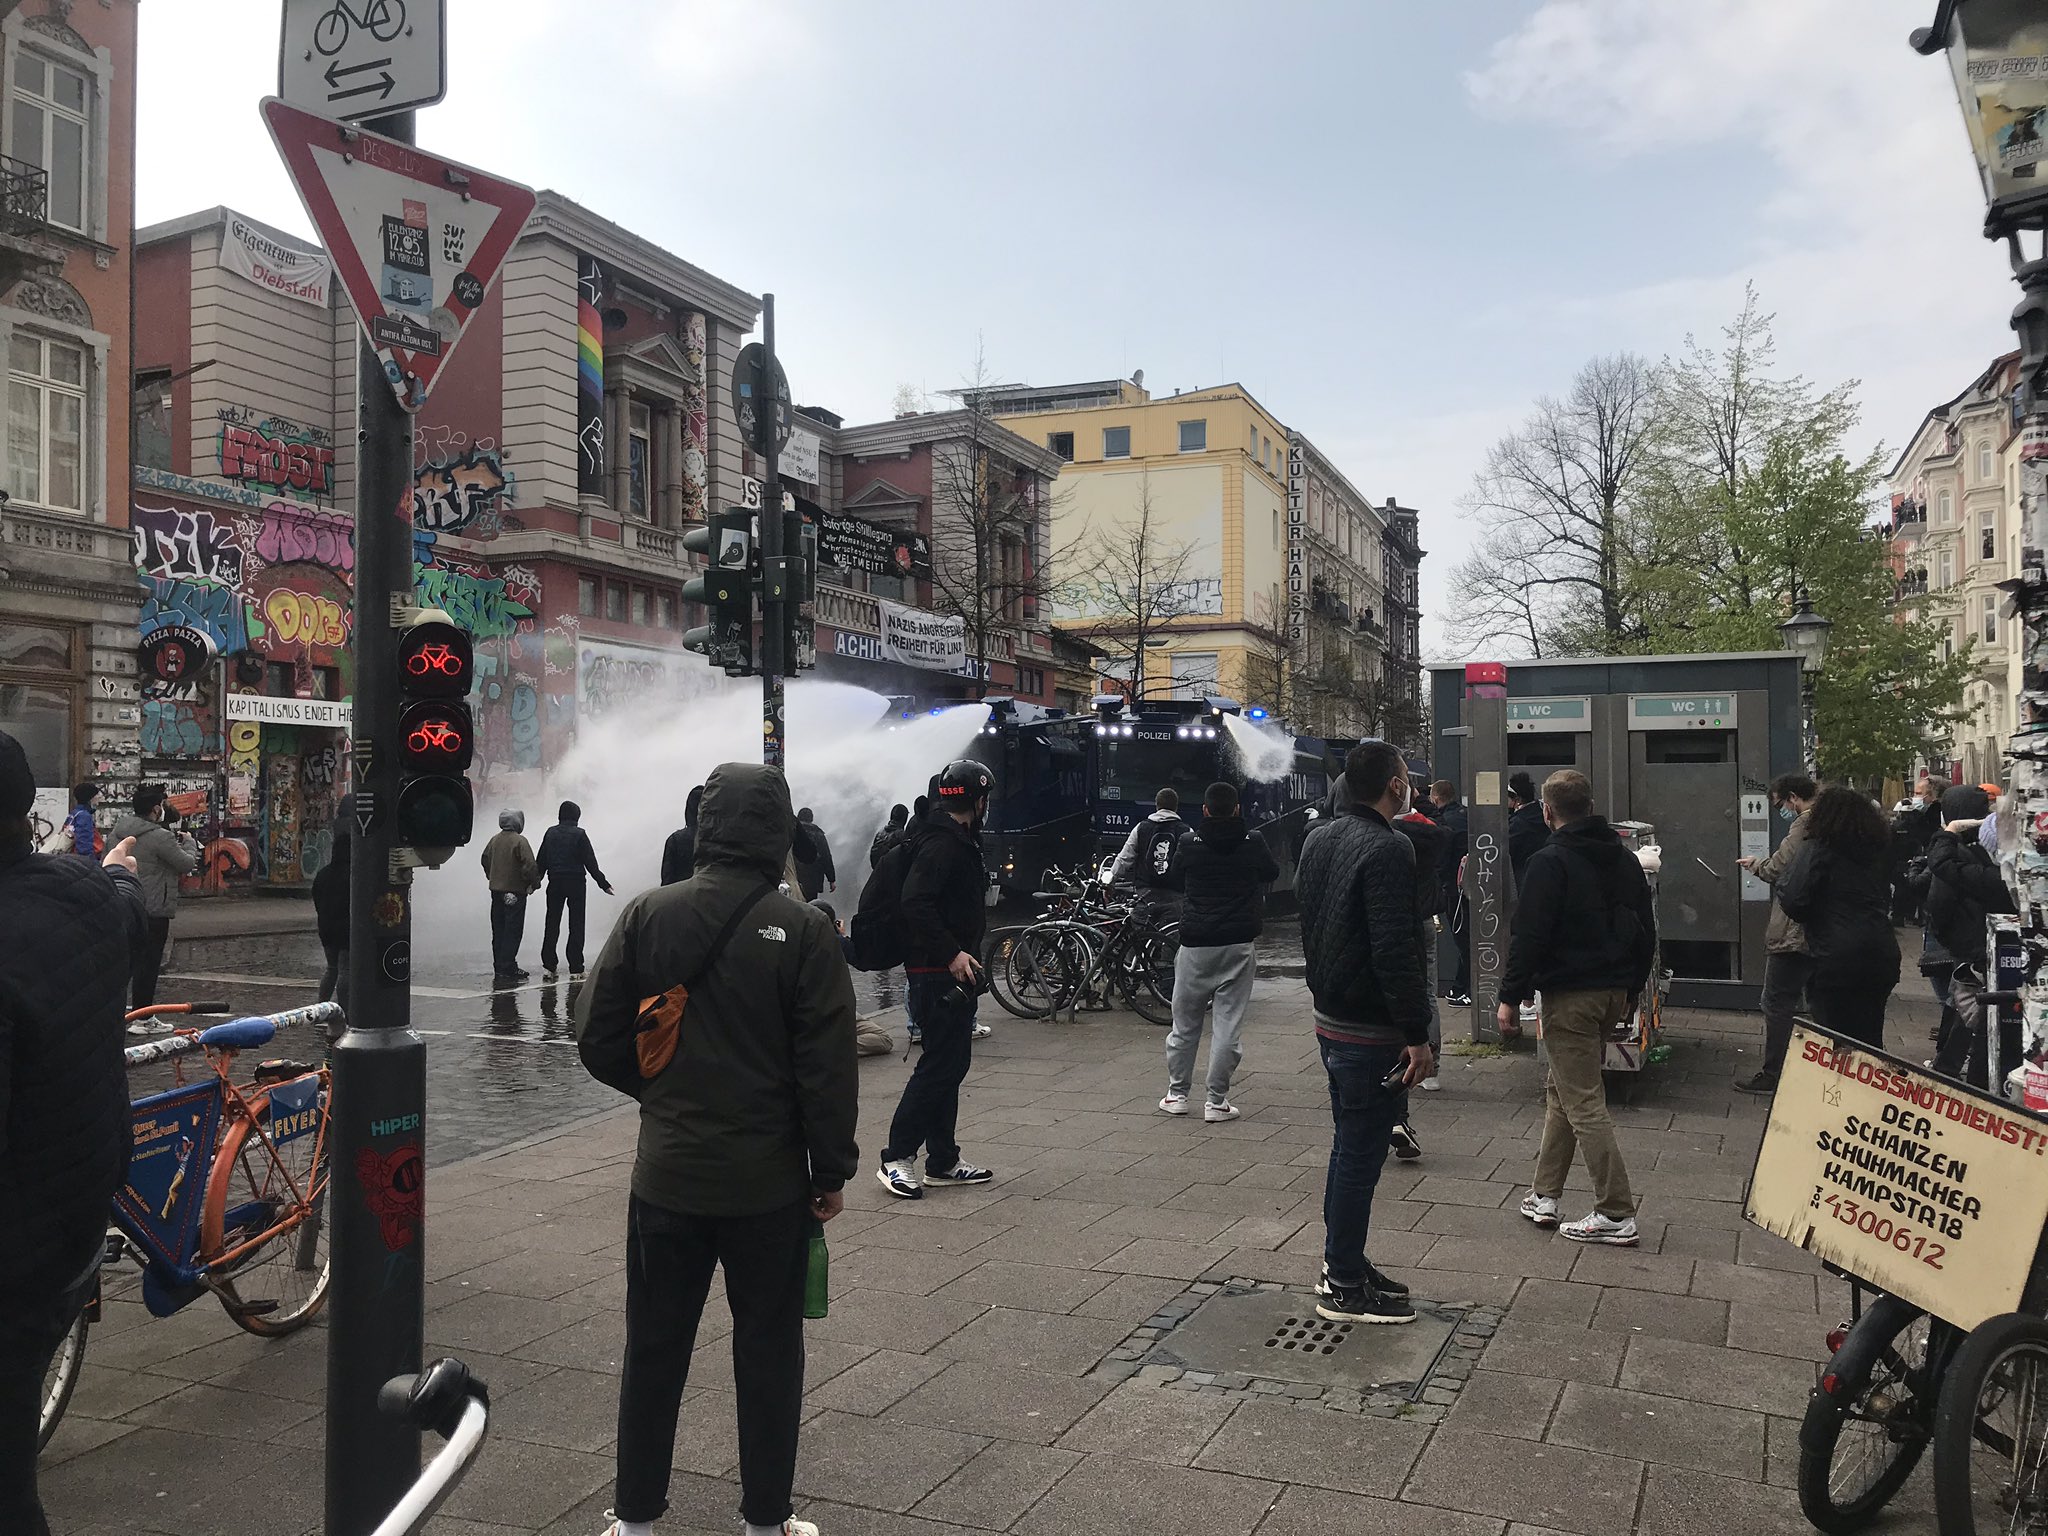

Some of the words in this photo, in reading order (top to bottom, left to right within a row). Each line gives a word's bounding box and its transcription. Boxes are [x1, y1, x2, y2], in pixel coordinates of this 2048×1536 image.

[232, 220, 297, 266] Eigentum
[252, 263, 323, 302] Diebstahl
[380, 328, 400, 341] ANTIFA
[401, 334, 421, 347] ALTONA
[833, 553, 884, 573] WELTWEIT!
[887, 614, 917, 634] NAZIS
[144, 628, 170, 649] PIZZA
[174, 628, 202, 649] PAZZA
[930, 638, 945, 655] FÜR
[228, 699, 301, 720] KAPITALISMUS
[304, 705, 334, 721] ENDET
[1528, 705, 1551, 716] WC
[1671, 702, 1696, 712] WC
[1137, 731, 1171, 741] POLIZEI
[1106, 814, 1123, 825] STA
[1124, 815, 1130, 825] 2
[1802, 1040, 2048, 1156] SCHLOSSNOTDIENST!
[274, 1108, 317, 1139] FLYER
[1844, 1115, 1968, 1183] SCHANZEN
[1816, 1130, 1982, 1221] SCHUHMACHER
[1824, 1193, 1947, 1270] 4300612
